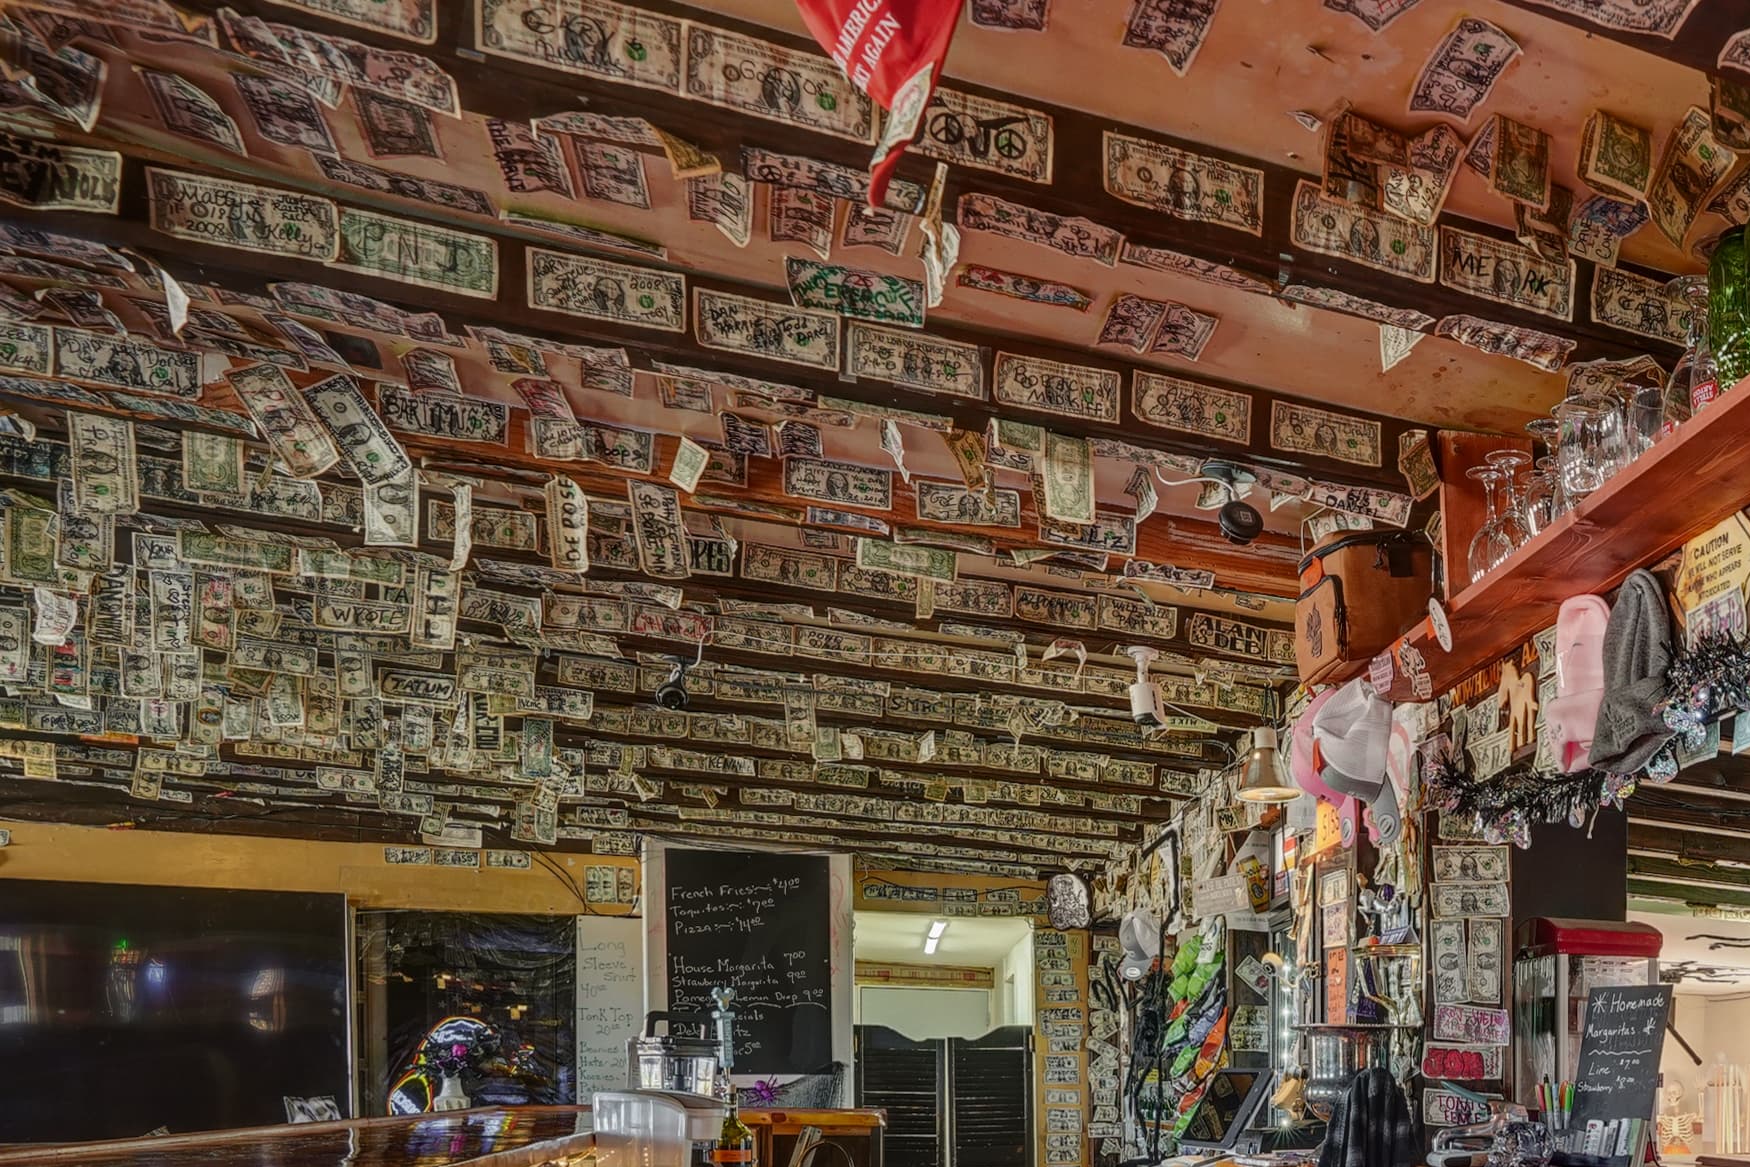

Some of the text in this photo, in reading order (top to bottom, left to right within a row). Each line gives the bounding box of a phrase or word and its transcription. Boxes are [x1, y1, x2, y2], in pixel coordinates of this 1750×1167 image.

[861, 12, 901, 69] AGAIN
[1694, 531, 1729, 560] CAUTION
[1722, 543, 1742, 562] SERVE
[1200, 615, 1262, 642] ALAN
[671, 885, 752, 900] French Fries
[579, 927, 625, 956] Long
[583, 957, 627, 970] Sleeve
[673, 956, 714, 974] House
[718, 956, 774, 977] Margarita
[1586, 1022, 1635, 1043] Margaritas
